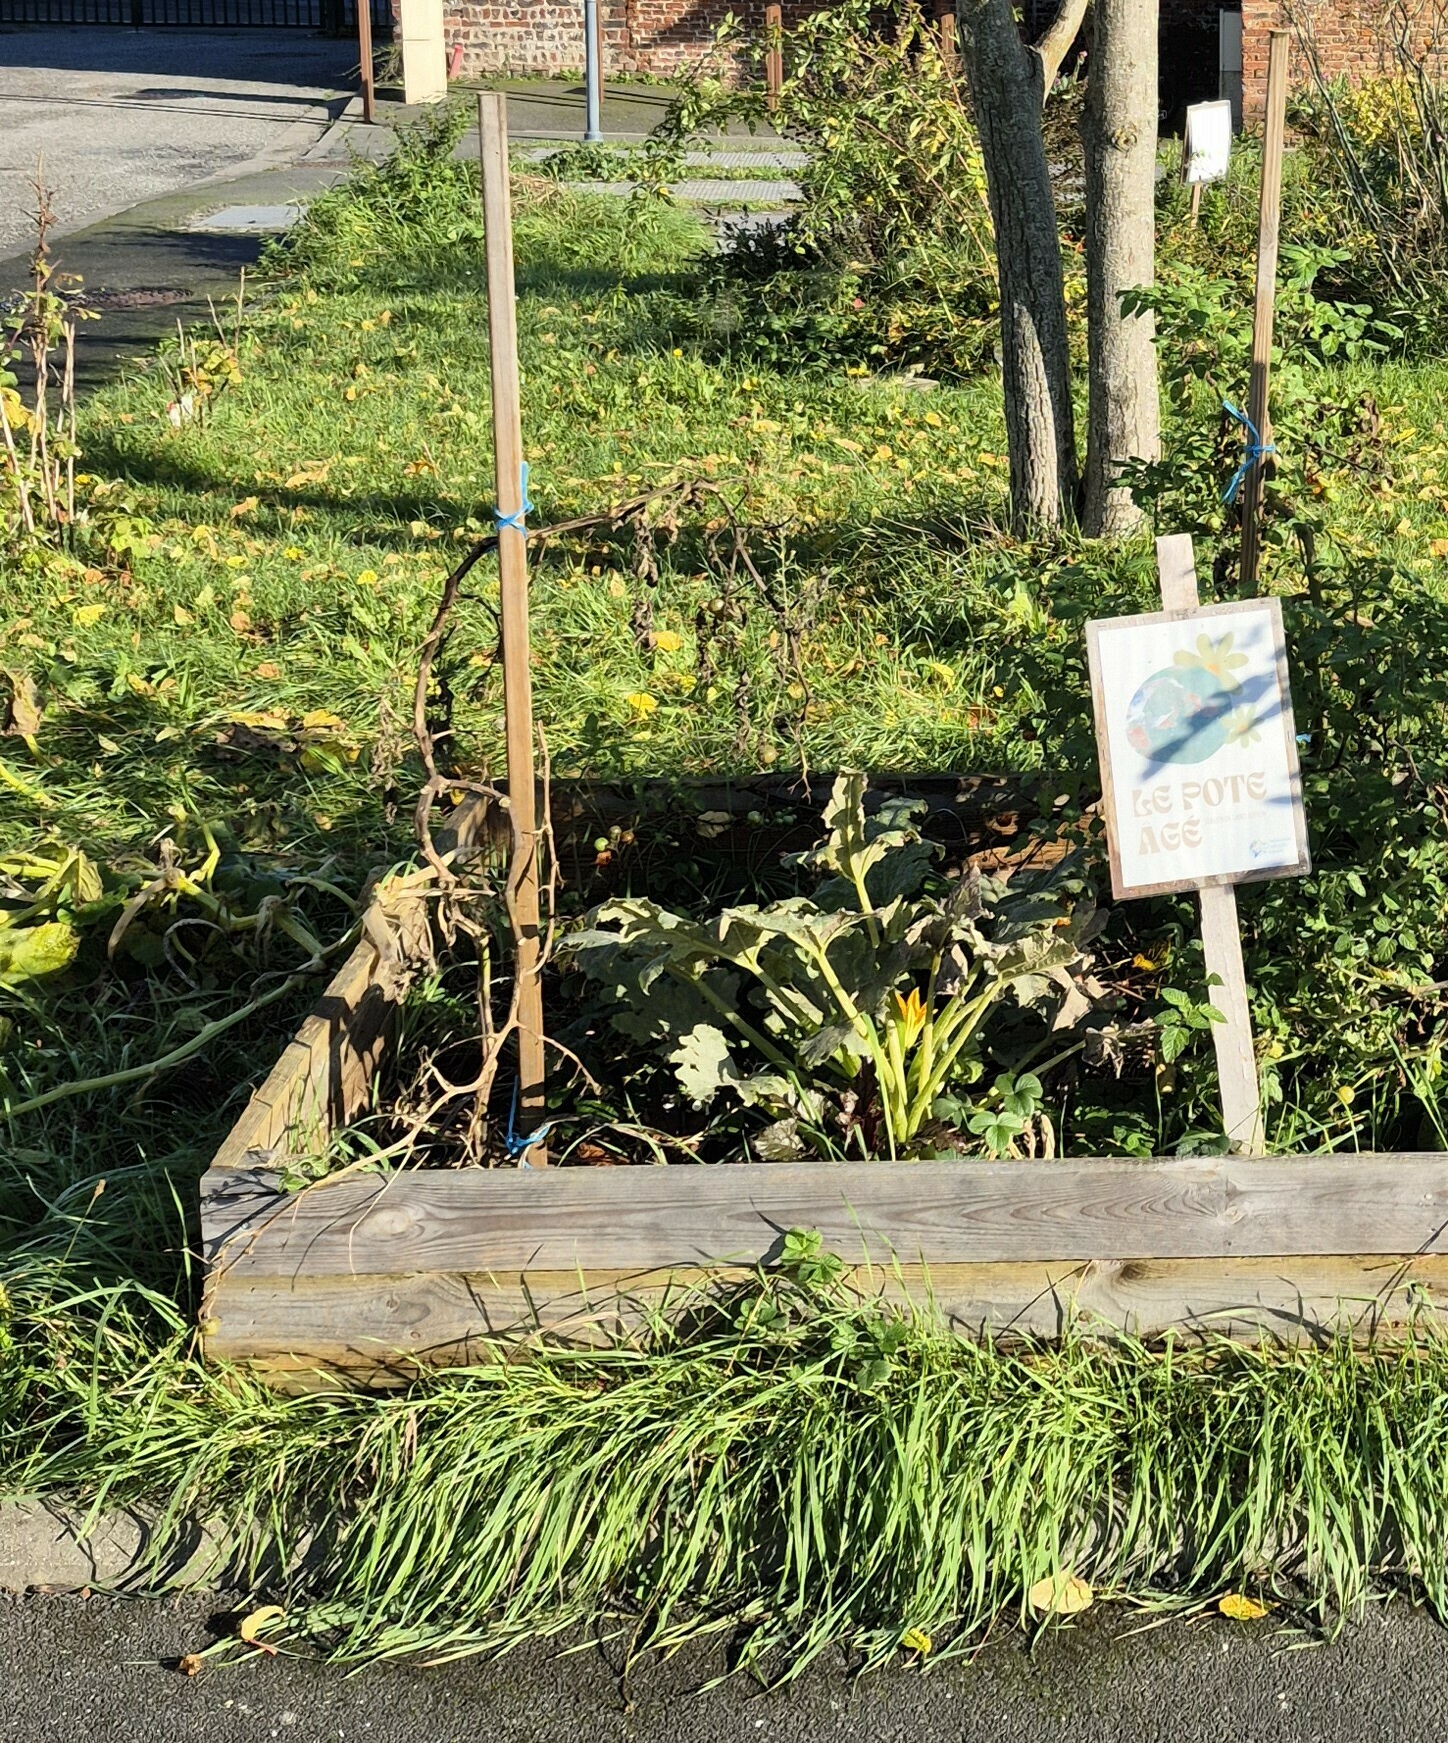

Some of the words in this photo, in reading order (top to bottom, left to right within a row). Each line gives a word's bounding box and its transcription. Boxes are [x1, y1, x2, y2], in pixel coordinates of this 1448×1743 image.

[1131, 784, 1173, 818] LE
[1181, 771, 1268, 811] POTE
[1138, 813, 1203, 856] ÂGÉ
